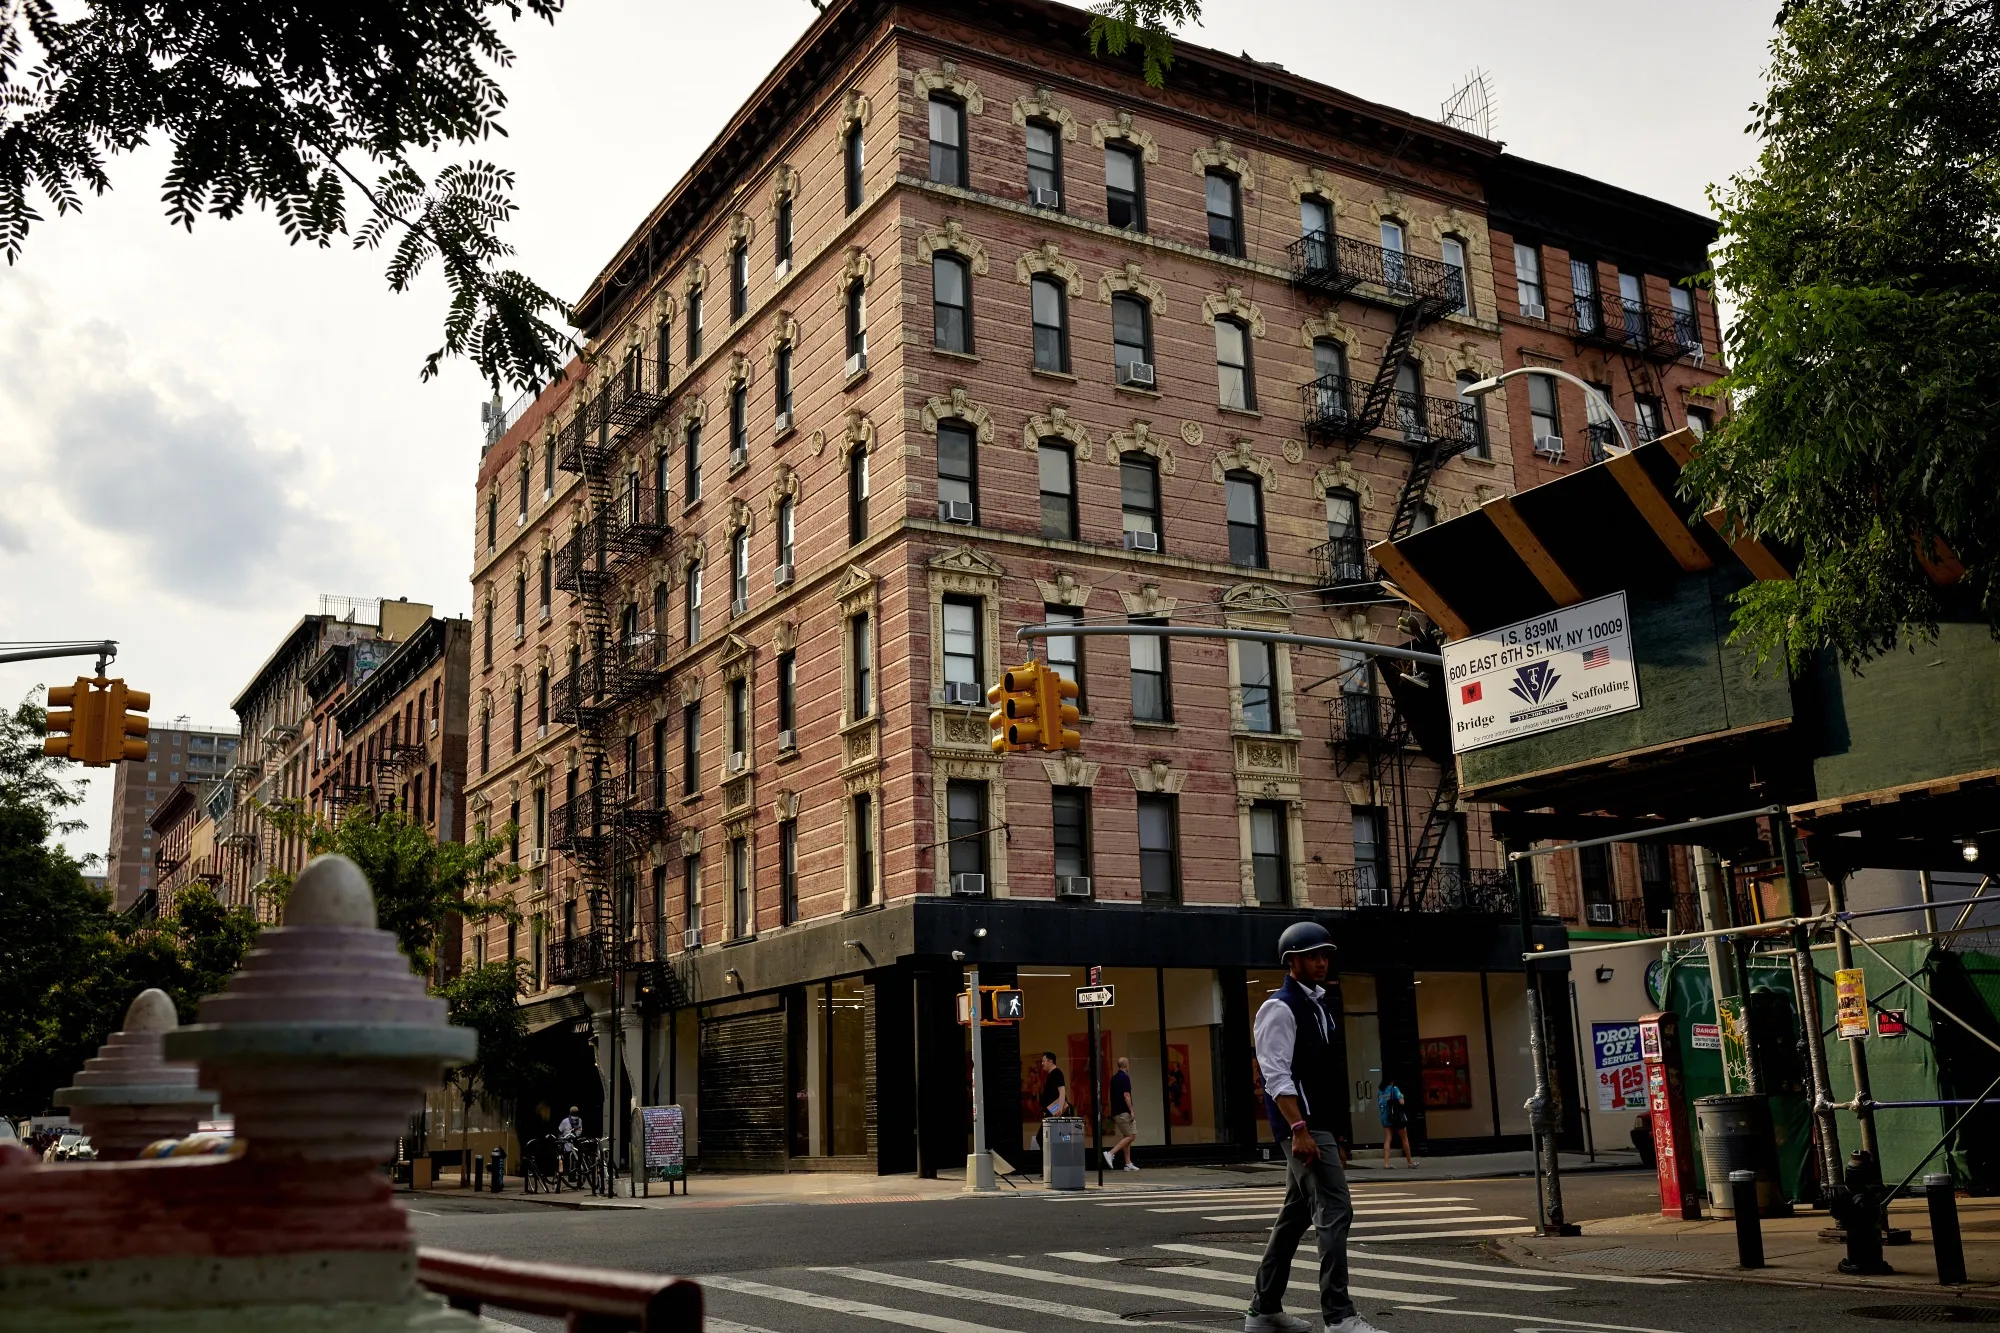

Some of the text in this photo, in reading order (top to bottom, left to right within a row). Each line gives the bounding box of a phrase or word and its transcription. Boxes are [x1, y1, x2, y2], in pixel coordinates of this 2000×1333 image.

[1501, 618, 1558, 648] I.S. 839M
[1449, 618, 1623, 681] 600 EAST 6TH ST. NY, NY 10009
[1571, 680, 1630, 702] Scaffolding
[1457, 714, 1496, 733] Bridge
[1596, 1026, 1640, 1045] DROP
[1880, 1024, 1903, 1032] PARKING
[1602, 1039, 1636, 1056] OFF
[1602, 1052, 1639, 1066] SERVICE
